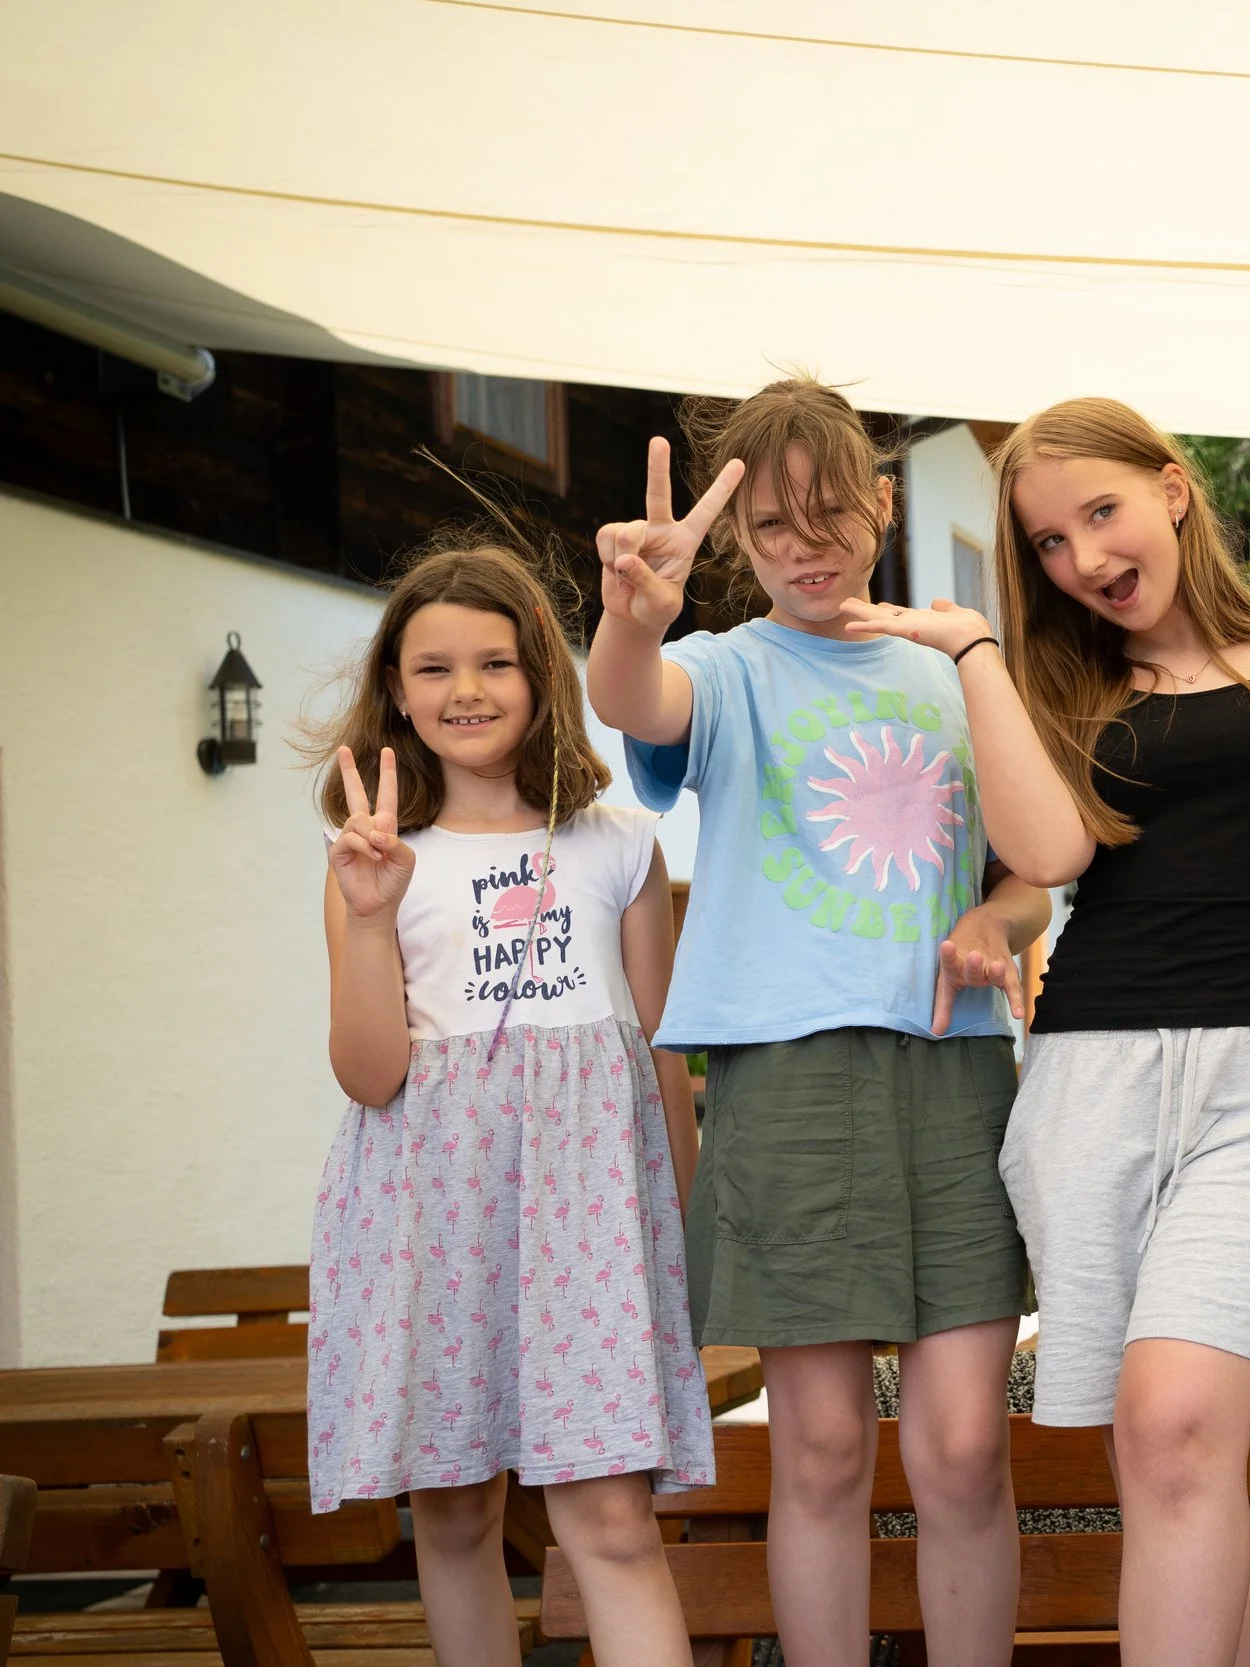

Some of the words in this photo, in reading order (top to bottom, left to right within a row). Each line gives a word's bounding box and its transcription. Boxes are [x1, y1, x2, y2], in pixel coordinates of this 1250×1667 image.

[472, 853, 538, 904] pink
[472, 909, 490, 938] is
[540, 905, 573, 934] my
[473, 935, 572, 975] HAPPY
